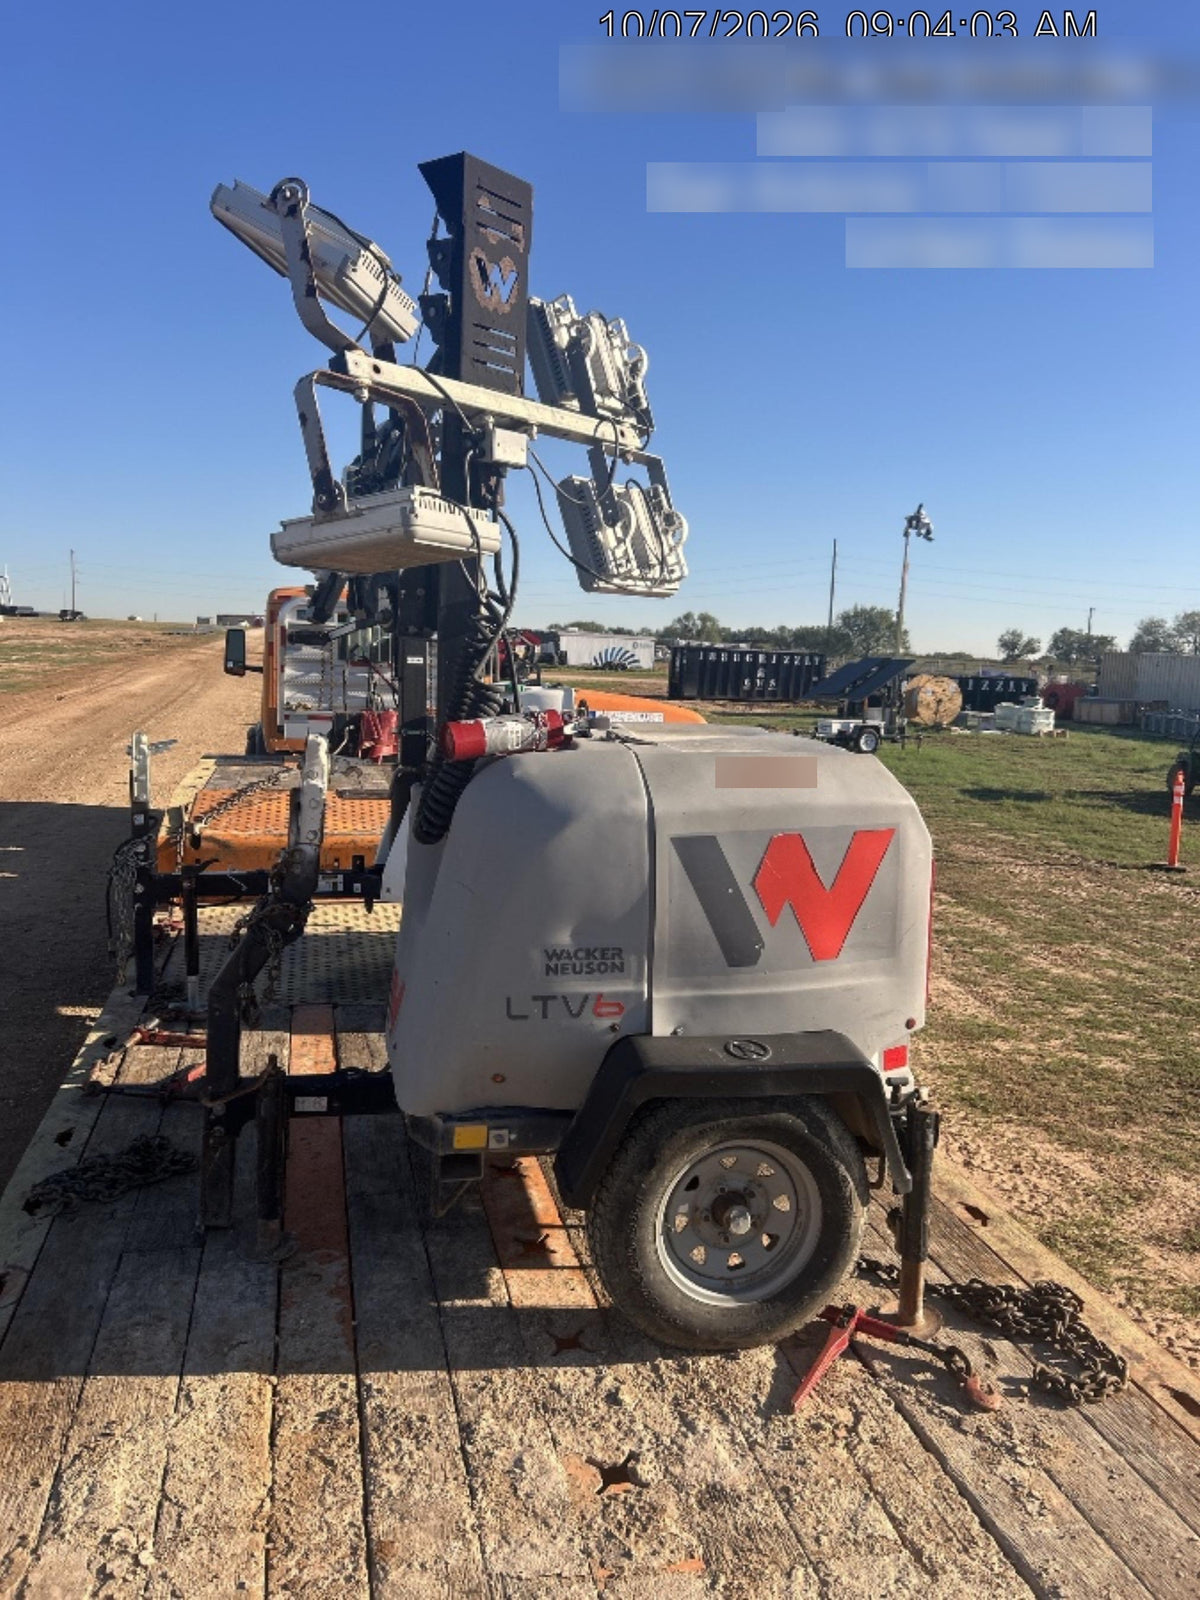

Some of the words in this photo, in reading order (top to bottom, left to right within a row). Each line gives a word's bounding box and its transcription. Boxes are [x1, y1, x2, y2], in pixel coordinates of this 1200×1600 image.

[544, 947, 624, 961] WACKER
[545, 961, 624, 976] NEUSON
[506, 991, 625, 1020] LTV6
